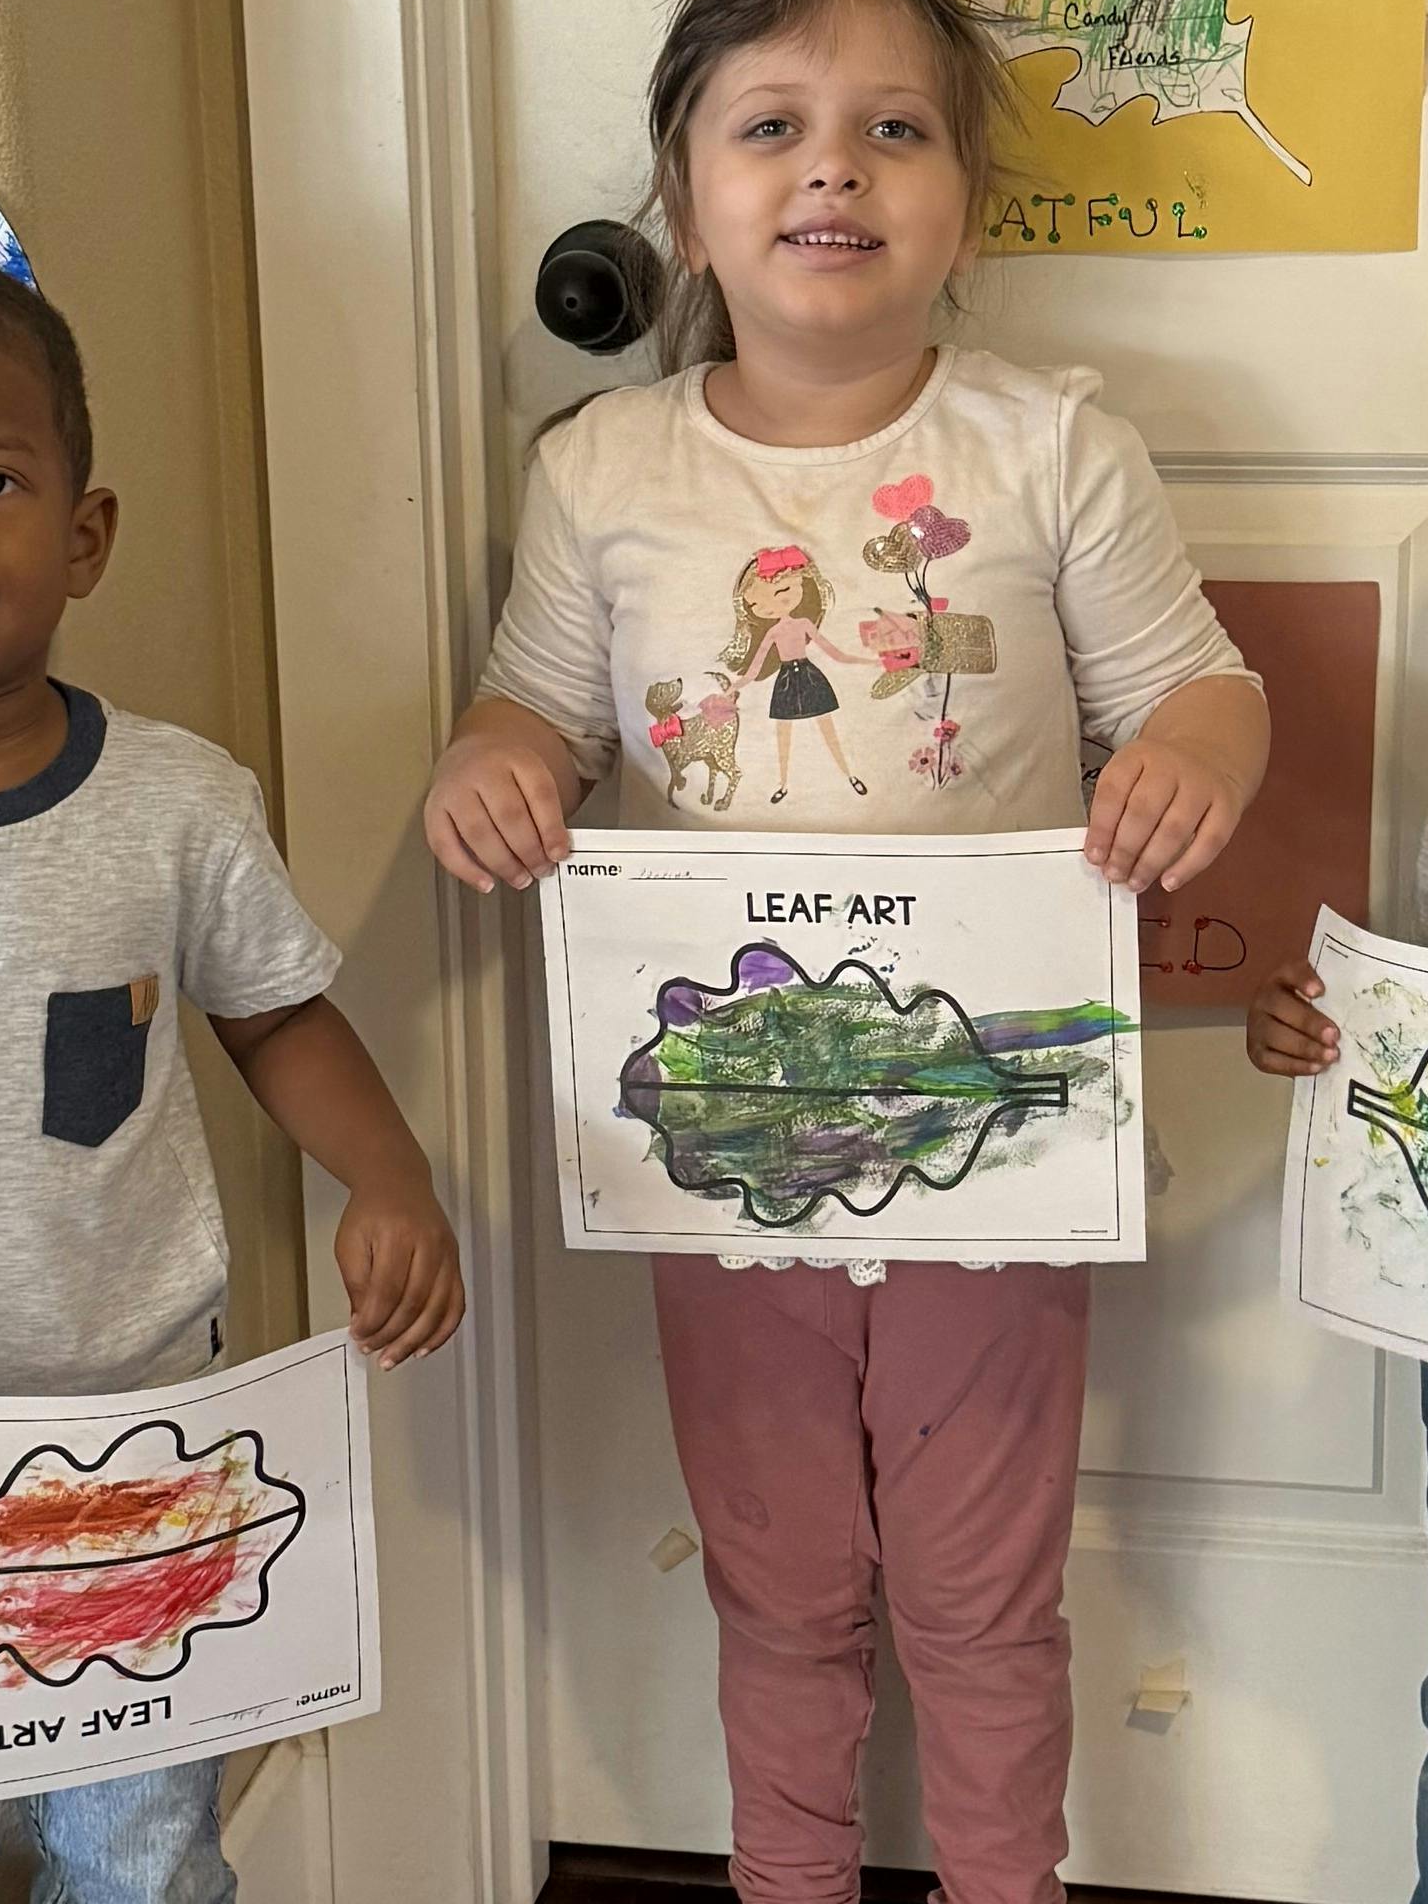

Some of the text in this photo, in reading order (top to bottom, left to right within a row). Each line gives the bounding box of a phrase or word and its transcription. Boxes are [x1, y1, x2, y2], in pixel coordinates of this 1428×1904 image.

[1064, 2, 1130, 42] Candy
[567, 864, 622, 877] name:
[747, 892, 917, 927] LEAF ART
[295, 1682, 352, 1709] name:
[81, 1695, 172, 1739] LEAF
